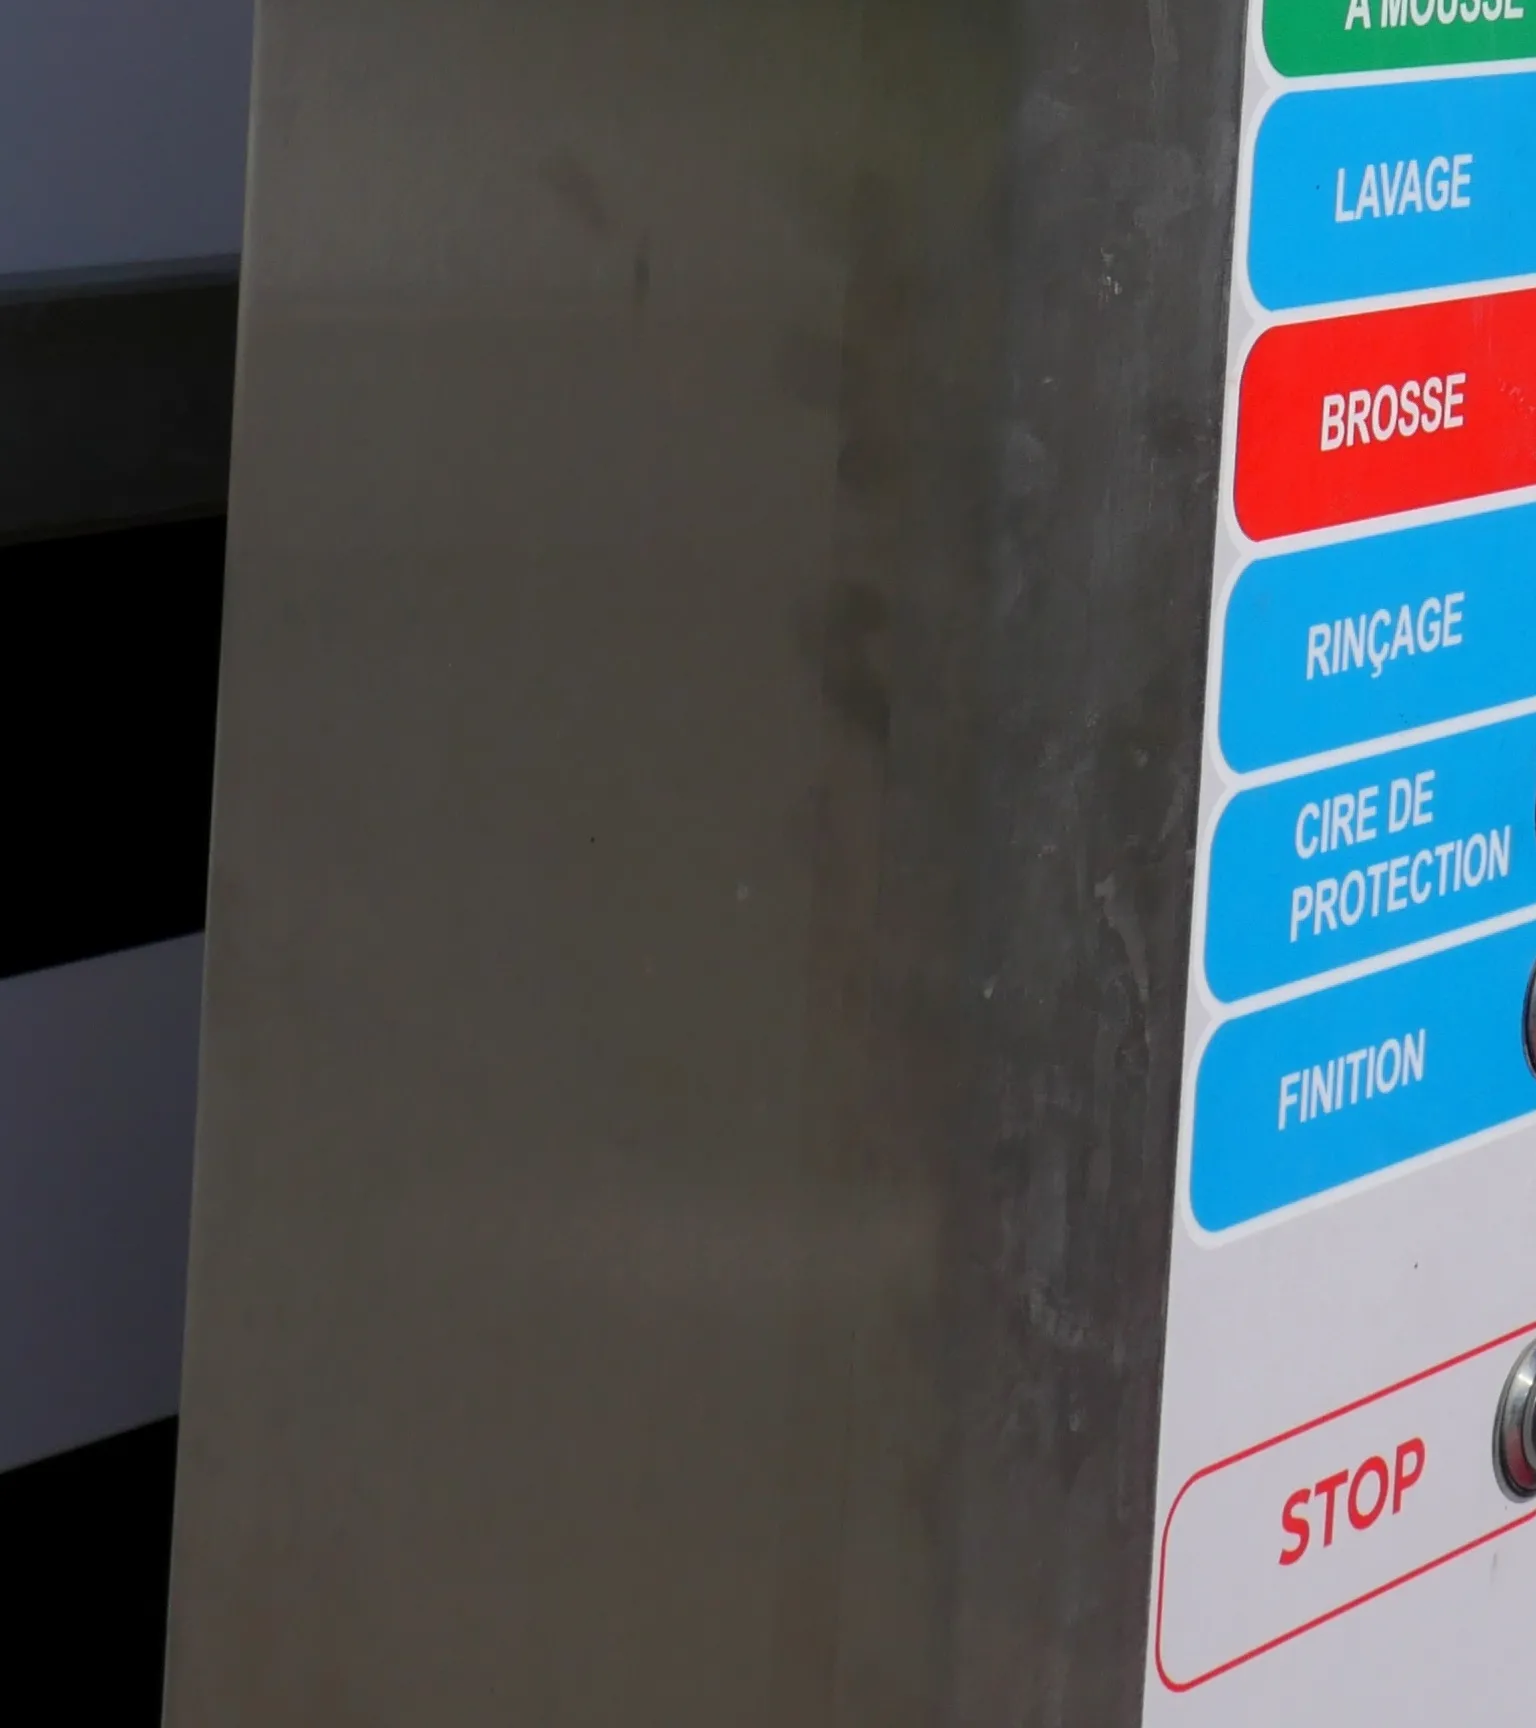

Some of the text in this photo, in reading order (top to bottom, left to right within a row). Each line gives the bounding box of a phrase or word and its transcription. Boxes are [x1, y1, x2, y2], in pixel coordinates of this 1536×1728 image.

[1334, 153, 1474, 223] LAVAGE
[1320, 372, 1466, 452] BROSSE
[1305, 591, 1465, 680] RINÇAGE
[1294, 769, 1436, 860] CIRE DE
[1290, 825, 1511, 943] PROTECTION
[1277, 1029, 1426, 1131] FINITION
[1278, 1436, 1426, 1567] STOP
